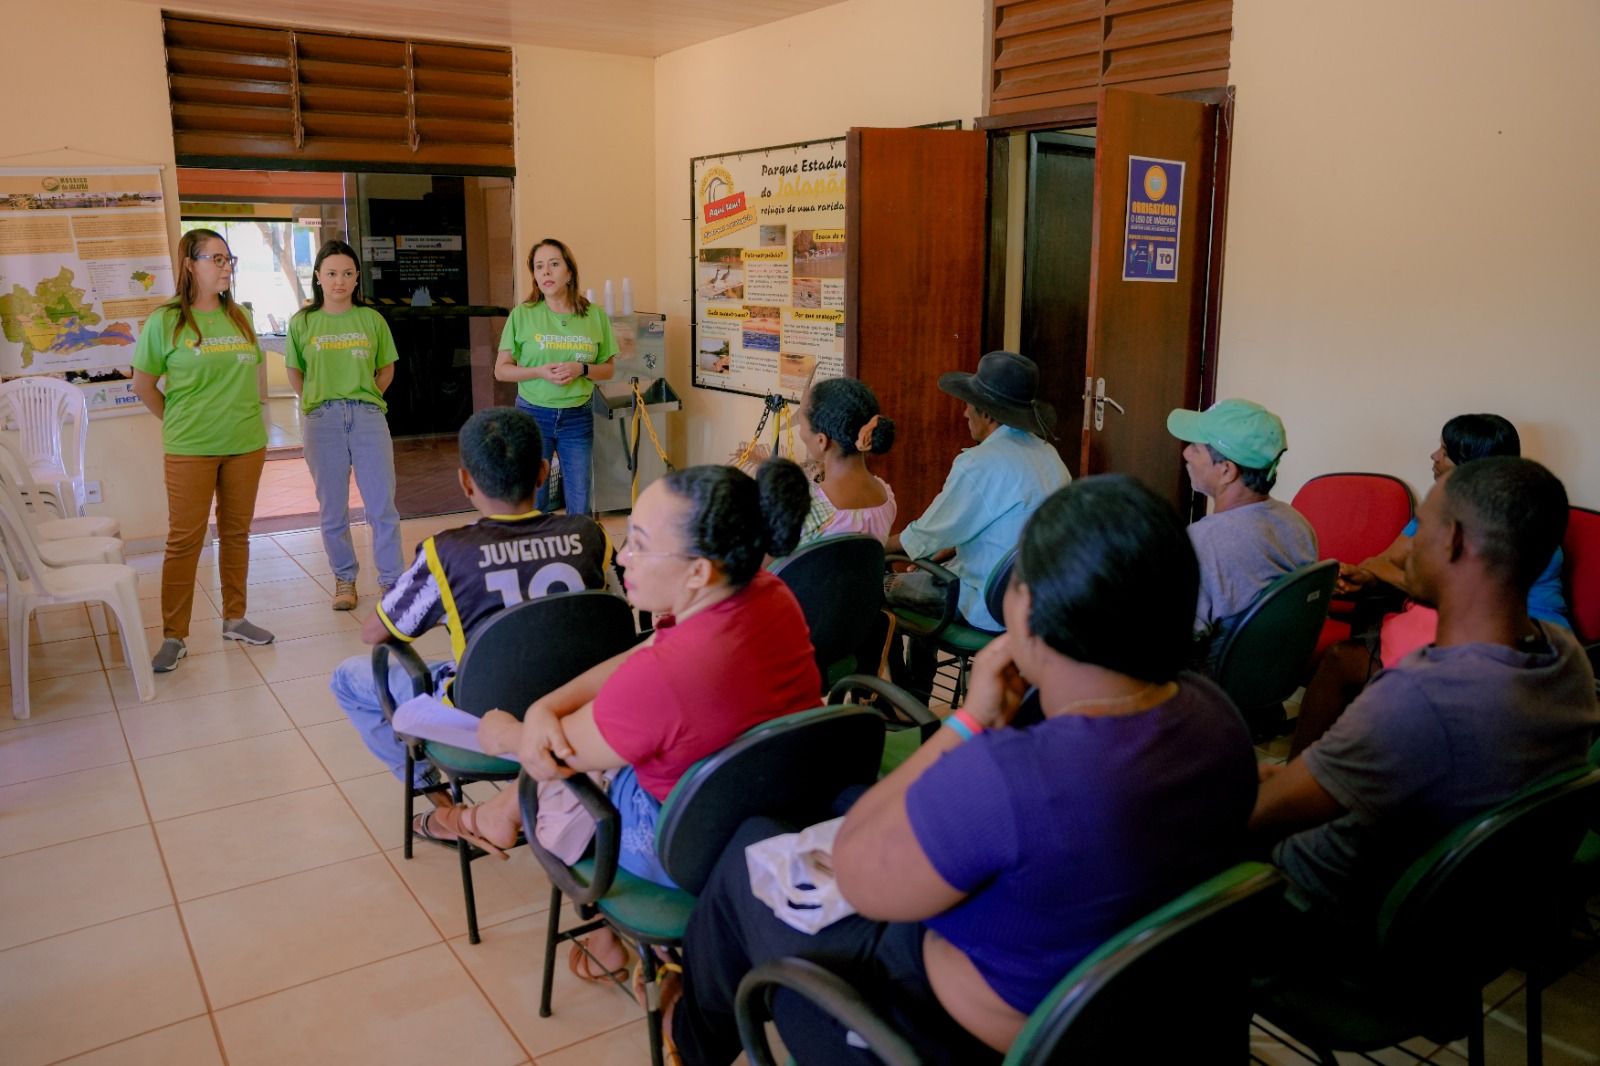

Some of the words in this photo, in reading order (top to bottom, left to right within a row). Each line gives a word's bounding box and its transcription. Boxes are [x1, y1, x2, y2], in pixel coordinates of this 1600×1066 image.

[761, 164, 798, 177] Parque
[761, 187, 772, 198] do
[787, 204, 796, 213] de
[1131, 201, 1176, 216] OBRIGATÓRIO
[1159, 254, 1172, 265] TO
[541, 335, 592, 344] DEFENSORIA
[545, 342, 594, 352] ITINERANTE
[478, 533, 583, 568] JUVENTUS
